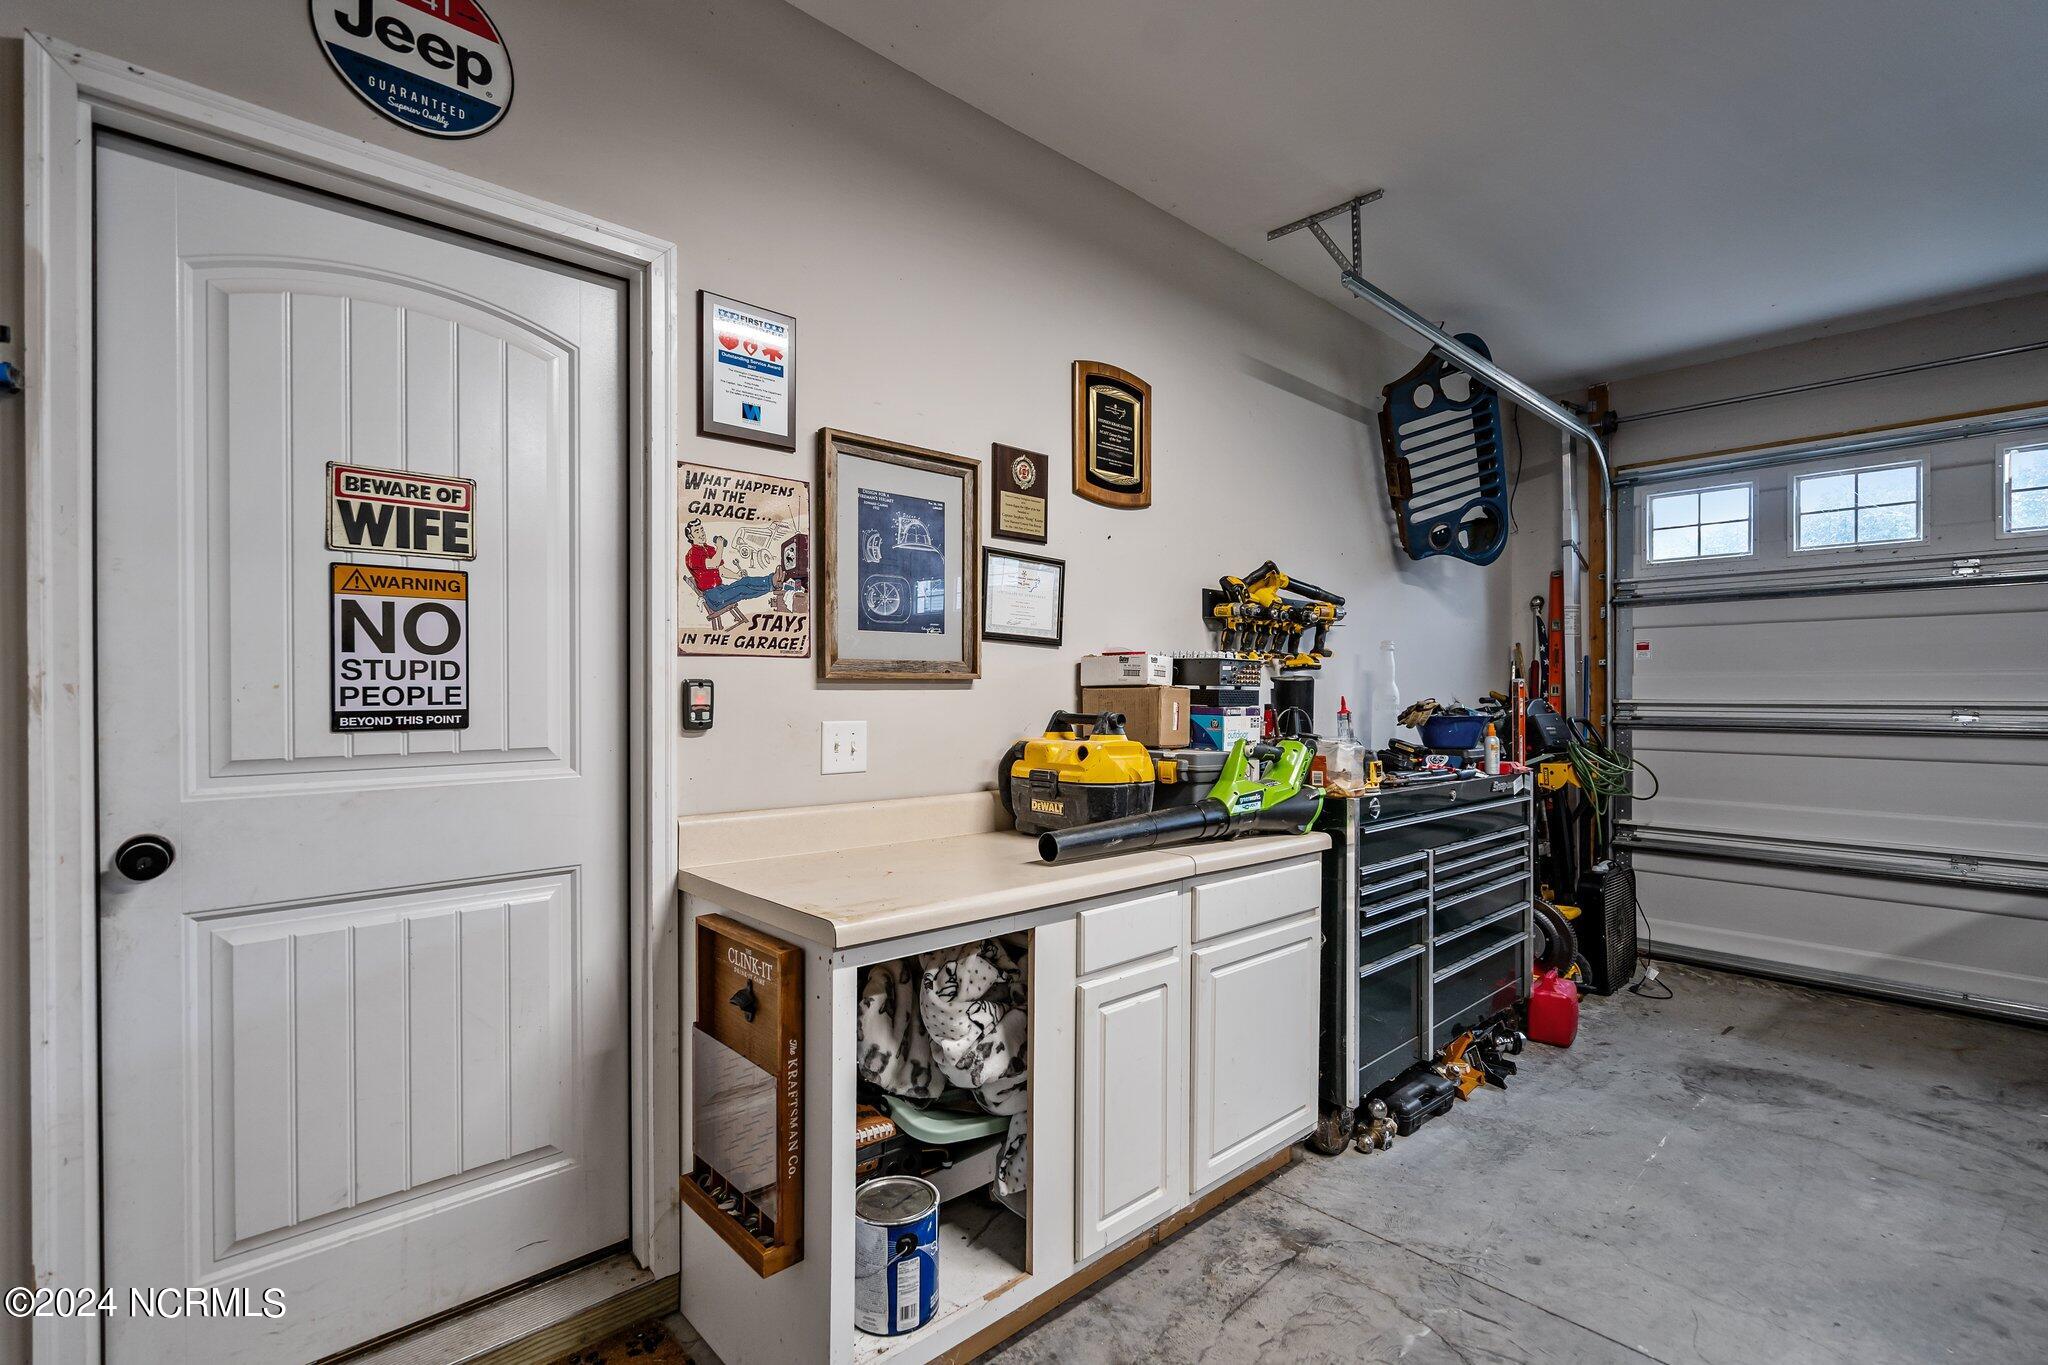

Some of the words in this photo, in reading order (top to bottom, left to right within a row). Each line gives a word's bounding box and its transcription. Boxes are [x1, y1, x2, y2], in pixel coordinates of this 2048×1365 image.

[334, 0, 493, 89] Jeep
[368, 76, 465, 119] GUARANTEED
[387, 96, 420, 115] Superior
[422, 108, 449, 128] Quality
[740, 315, 764, 327] FIRST
[344, 476, 431, 501] BEWARE
[436, 487, 462, 504] OF
[684, 470, 732, 490] WHAT
[735, 479, 795, 497] HAPPENS
[703, 487, 717, 500] IN
[722, 490, 746, 504] THE
[688, 500, 772, 522] GARAGE...
[336, 499, 470, 554] WIFE
[369, 574, 461, 593] WARNING
[341, 598, 461, 656] NO
[748, 613, 807, 633] STAYS
[681, 633, 697, 645] IN
[703, 633, 730, 645] THE
[733, 635, 807, 651] GARAGE!
[340, 658, 461, 681] STUPID
[339, 685, 462, 707] PEOPLE
[340, 717, 393, 727] BEYOND
[396, 716, 424, 725] THIS
[426, 715, 461, 724] POINT
[1032, 800, 1064, 815] DEWALT
[728, 947, 773, 981] CLINK-IT
[789, 1039, 798, 1056] The
[787, 1057, 799, 1152] KRAFTSMAN
[788, 1155, 799, 1180] Co.
